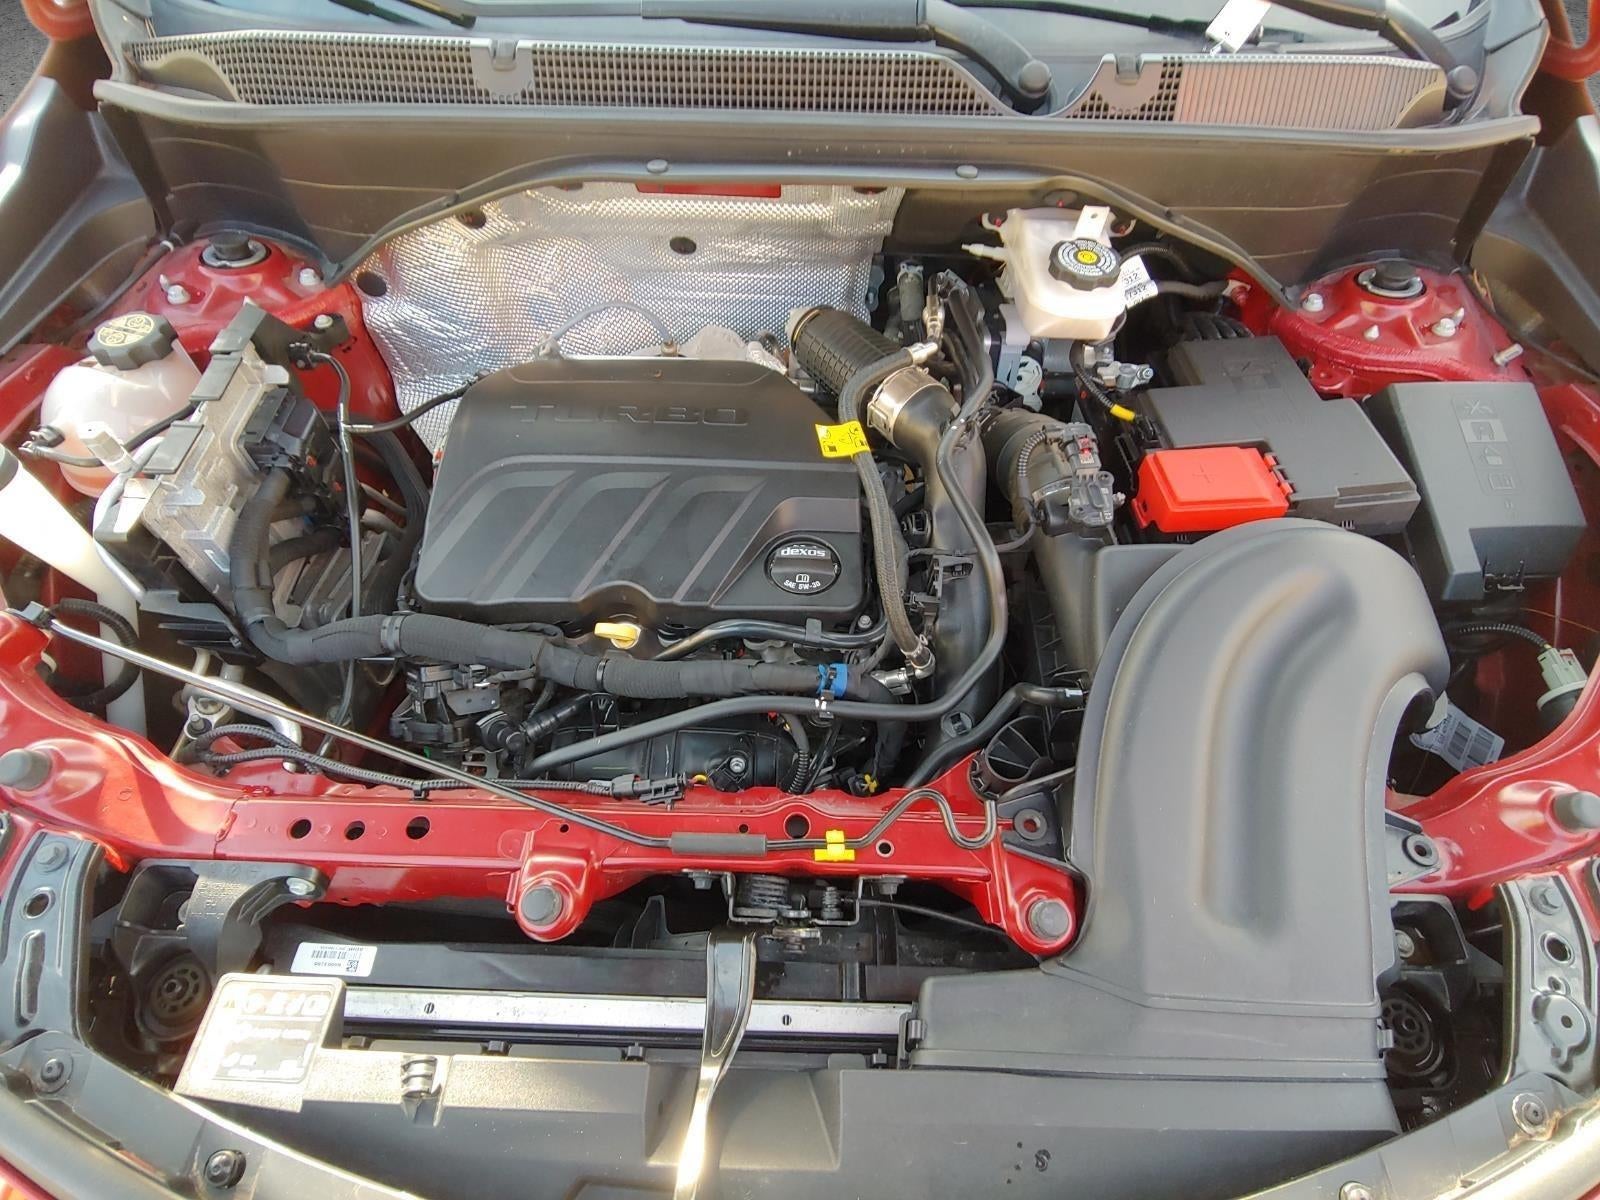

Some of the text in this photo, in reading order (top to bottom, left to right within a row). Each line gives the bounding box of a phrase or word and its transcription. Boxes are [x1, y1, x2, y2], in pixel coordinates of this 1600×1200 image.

[509, 404, 749, 426] TURBO
[781, 547, 826, 557] dexos
[783, 580, 821, 590] SAE 5W-30
